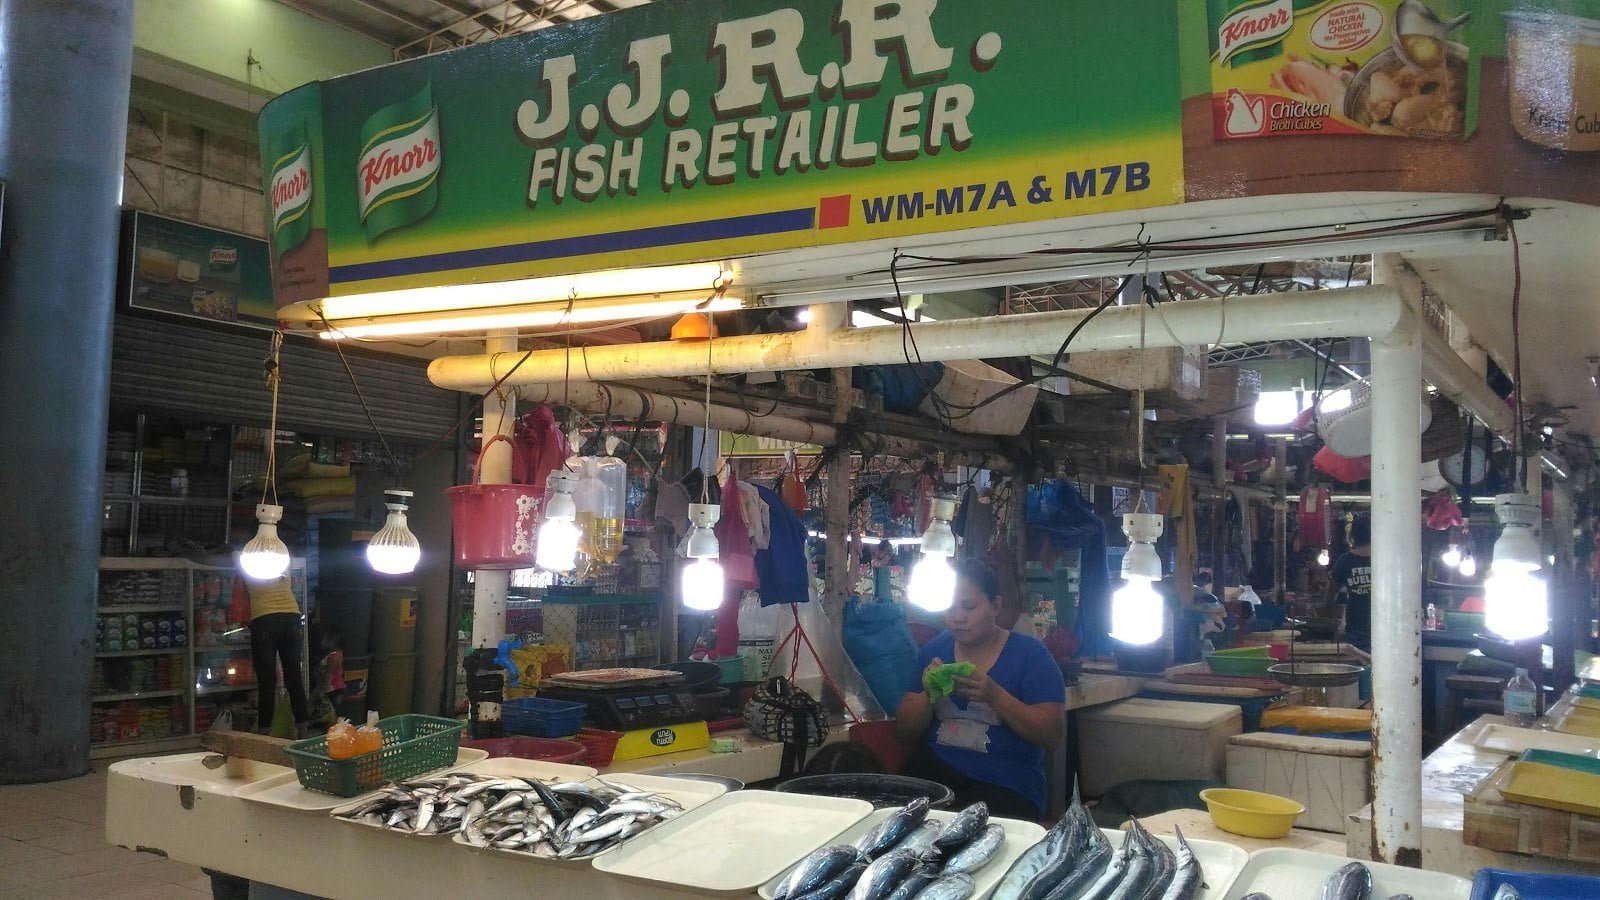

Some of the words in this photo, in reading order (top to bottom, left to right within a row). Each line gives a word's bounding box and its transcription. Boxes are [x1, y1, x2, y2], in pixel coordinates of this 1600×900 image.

[1221, 8, 1290, 48] Knorr
[1327, 13, 1367, 27] NATURAL
[1328, 21, 1364, 34] CHICKEN
[1270, 101, 1331, 120] Chicken
[1270, 119, 1294, 132] Broth
[1295, 117, 1322, 131] Cubes
[526, 137, 644, 206] FISH
[663, 83, 975, 188] RETAILER
[359, 138, 438, 197] Knorr
[271, 167, 310, 211] Knorr
[862, 180, 1017, 225] WM-M7A
[1026, 175, 1054, 206] &
[1064, 161, 1150, 200] M7B
